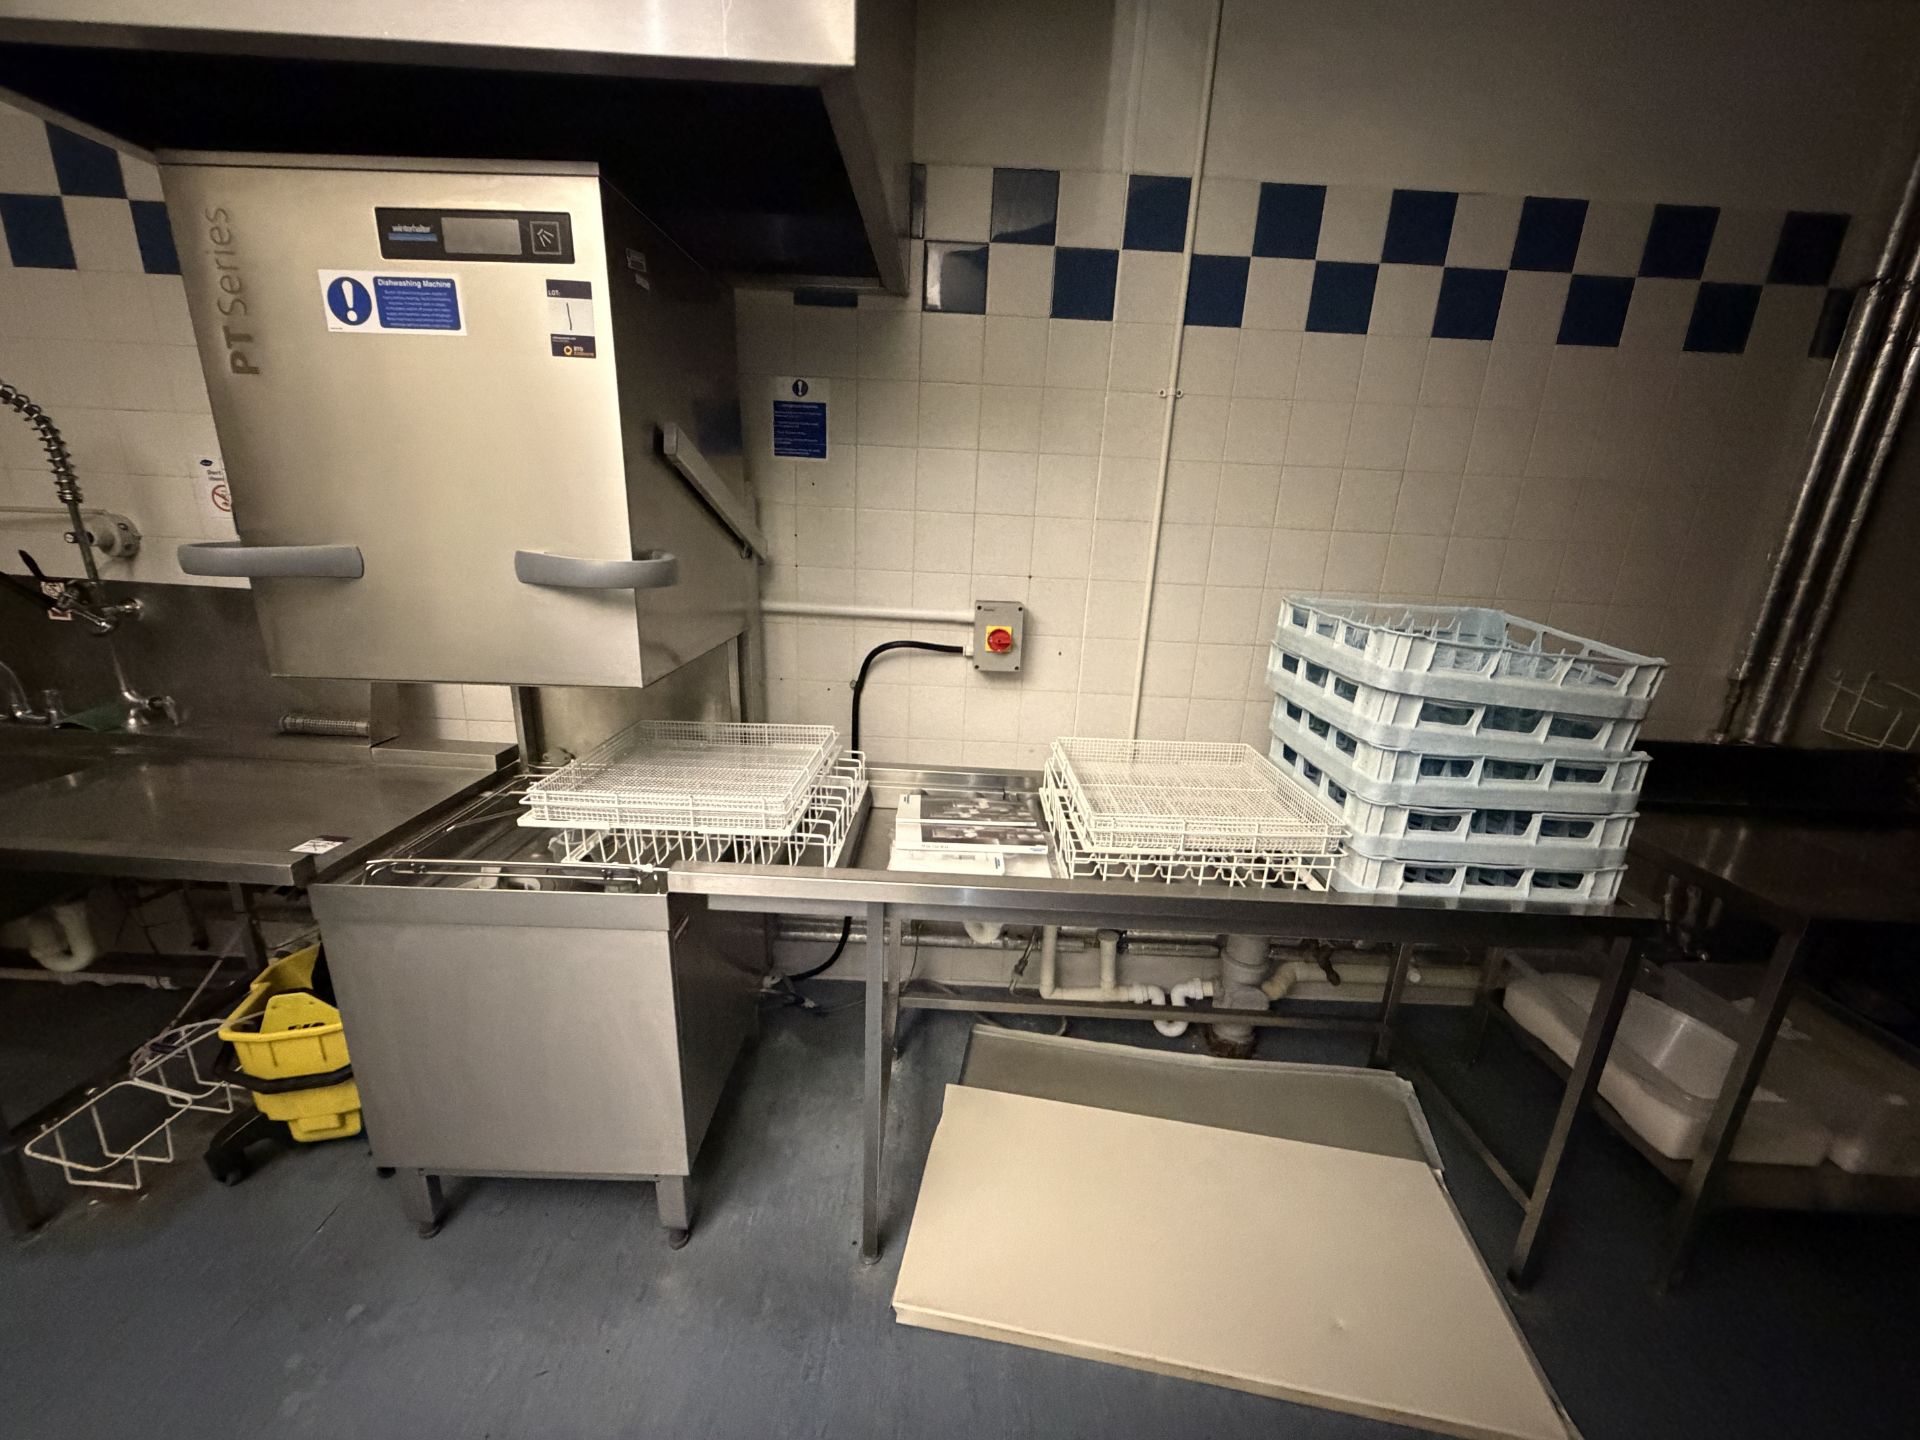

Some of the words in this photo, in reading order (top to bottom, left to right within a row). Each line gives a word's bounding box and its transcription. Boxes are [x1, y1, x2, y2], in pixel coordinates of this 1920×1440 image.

[205, 207, 248, 316] Series
[378, 279, 422, 288] Dishwashing
[423, 280, 451, 288] Machine
[222, 325, 260, 375] PT
